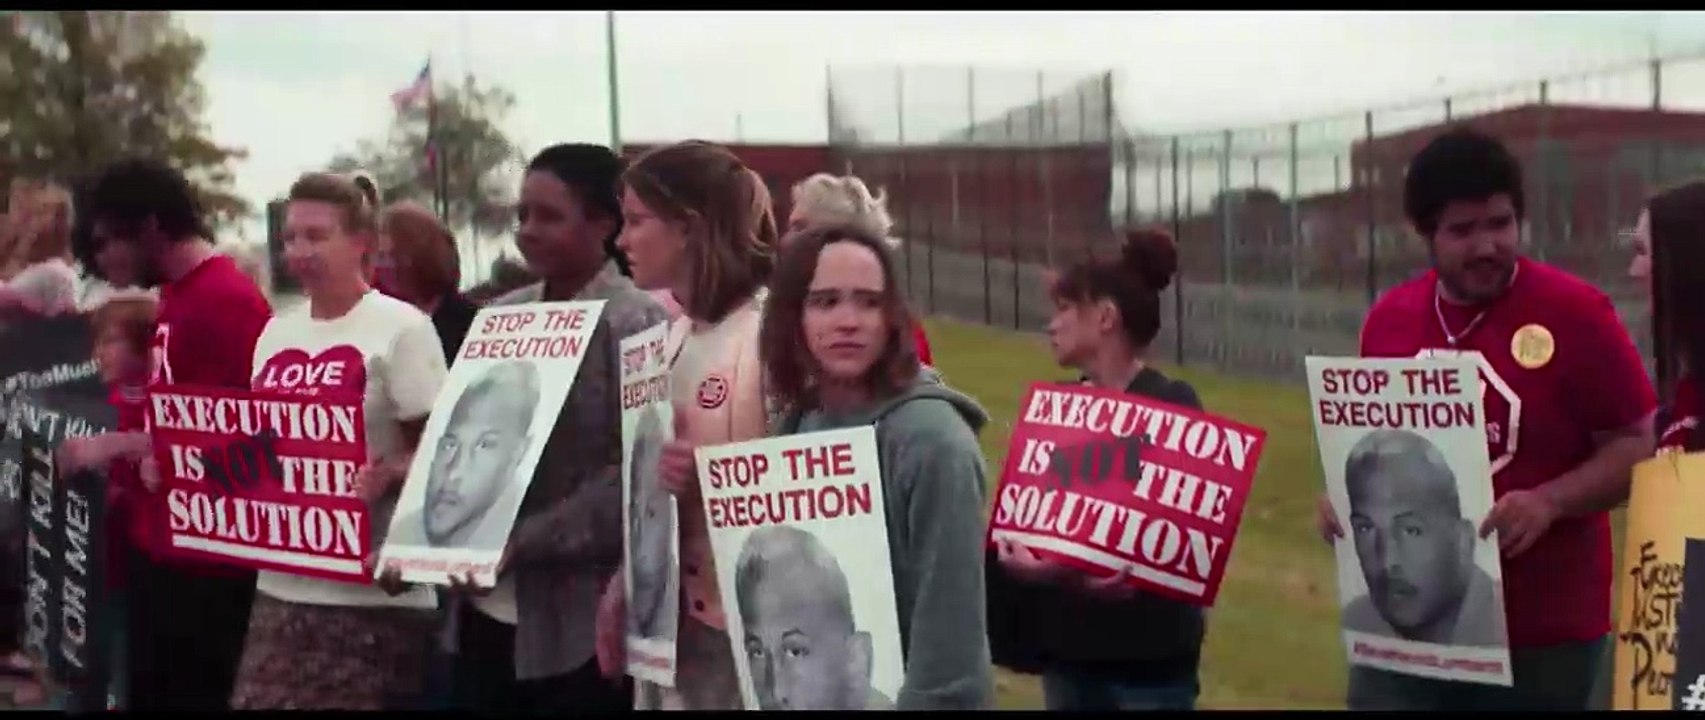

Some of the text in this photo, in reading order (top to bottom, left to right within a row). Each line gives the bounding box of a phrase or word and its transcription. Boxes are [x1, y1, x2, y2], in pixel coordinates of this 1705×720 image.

[481, 309, 587, 334] STOP THE
[463, 336, 584, 360] EXECUTION
[263, 361, 345, 388] LOVE
[1322, 368, 1462, 396] STOP THE
[151, 393, 356, 443] EXECUTION
[1024, 389, 1256, 471] EXECUTION
[1319, 400, 1476, 429] EXECUTION
[170, 429, 357, 497] IS NOT THE
[708, 443, 856, 489] STOP THE
[1019, 434, 1233, 525] IS NOT THE
[167, 488, 362, 556] SOLUTION
[708, 482, 872, 529] EXECUTION
[995, 483, 1224, 581] SOLUTION
